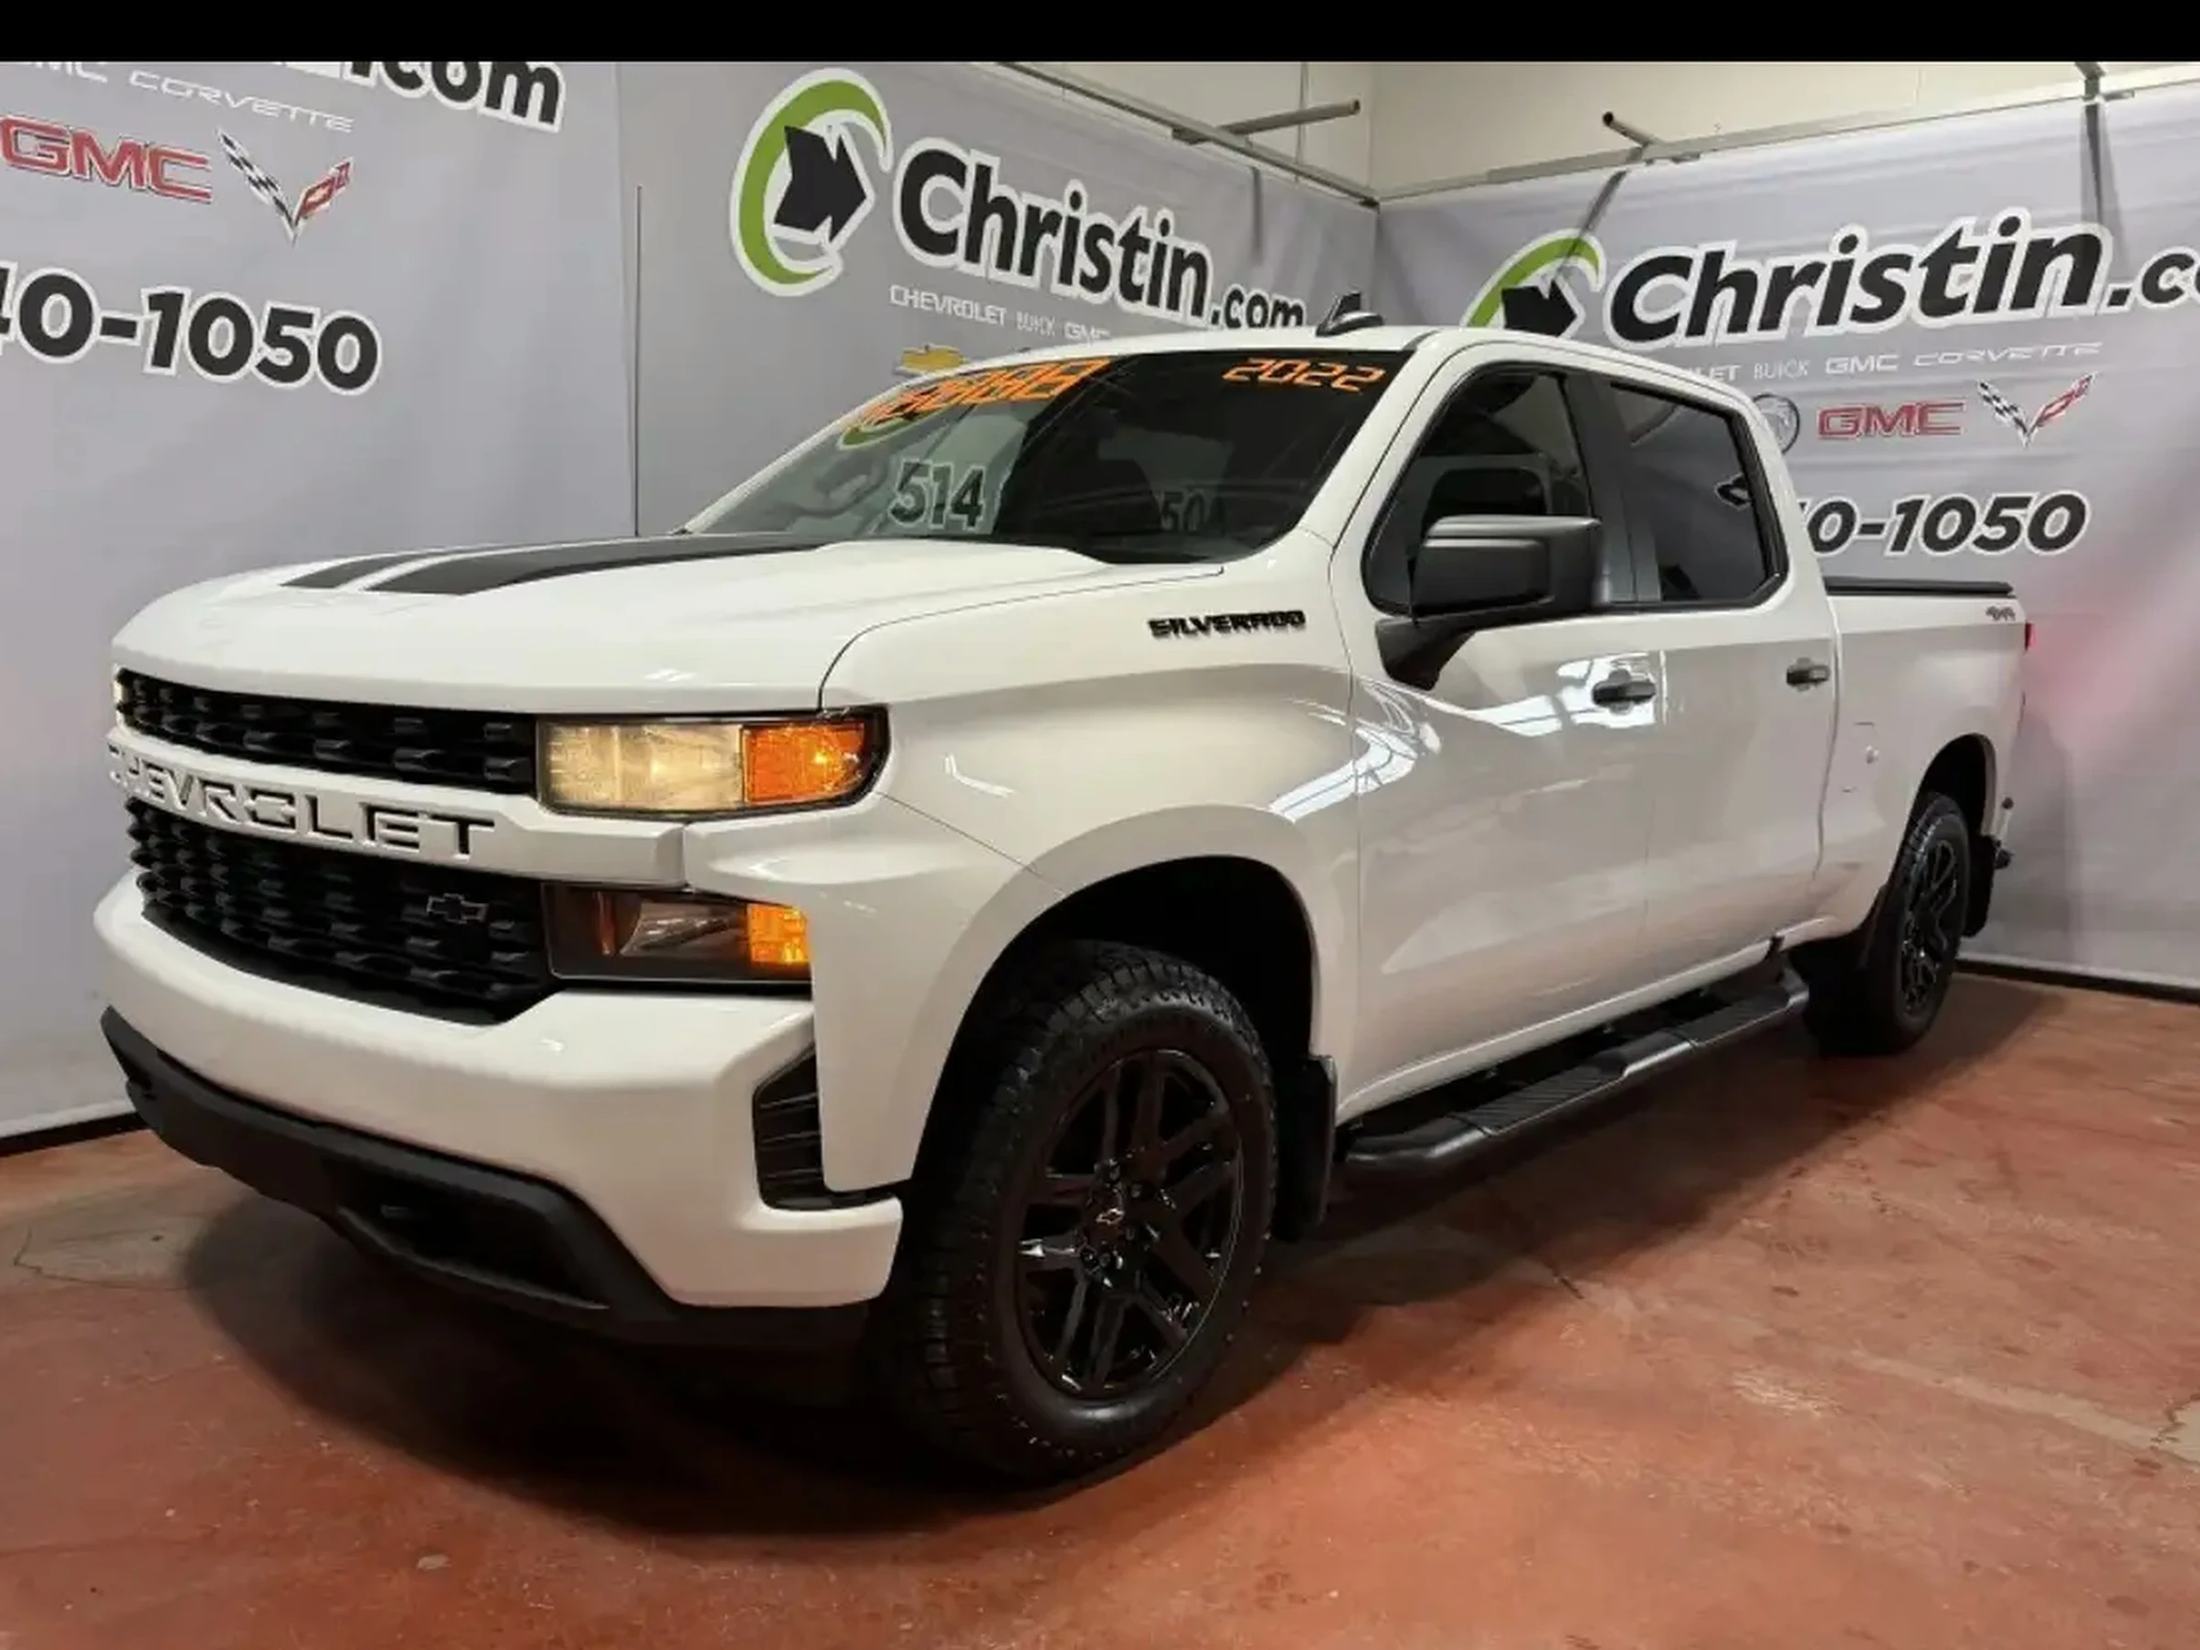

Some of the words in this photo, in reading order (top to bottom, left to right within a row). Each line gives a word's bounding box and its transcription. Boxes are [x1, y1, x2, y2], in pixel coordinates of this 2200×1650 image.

[129, 70, 354, 133] CORVETTE
[0, 114, 213, 205] GMC
[896, 143, 1306, 330] Christin.com
[889, 286, 1007, 327] CHEVROLET
[1606, 210, 2200, 346] Christin.c
[1221, 356, 1387, 392] 2022
[1753, 358, 1810, 379] BUICK
[1825, 354, 1899, 375] GMC
[1913, 342, 2102, 367] CORVETTE
[1818, 402, 1966, 439] GMC
[888, 458, 985, 531] 514
[1800, 491, 2090, 555] 0-1050
[1147, 609, 1306, 639] SILVERADO
